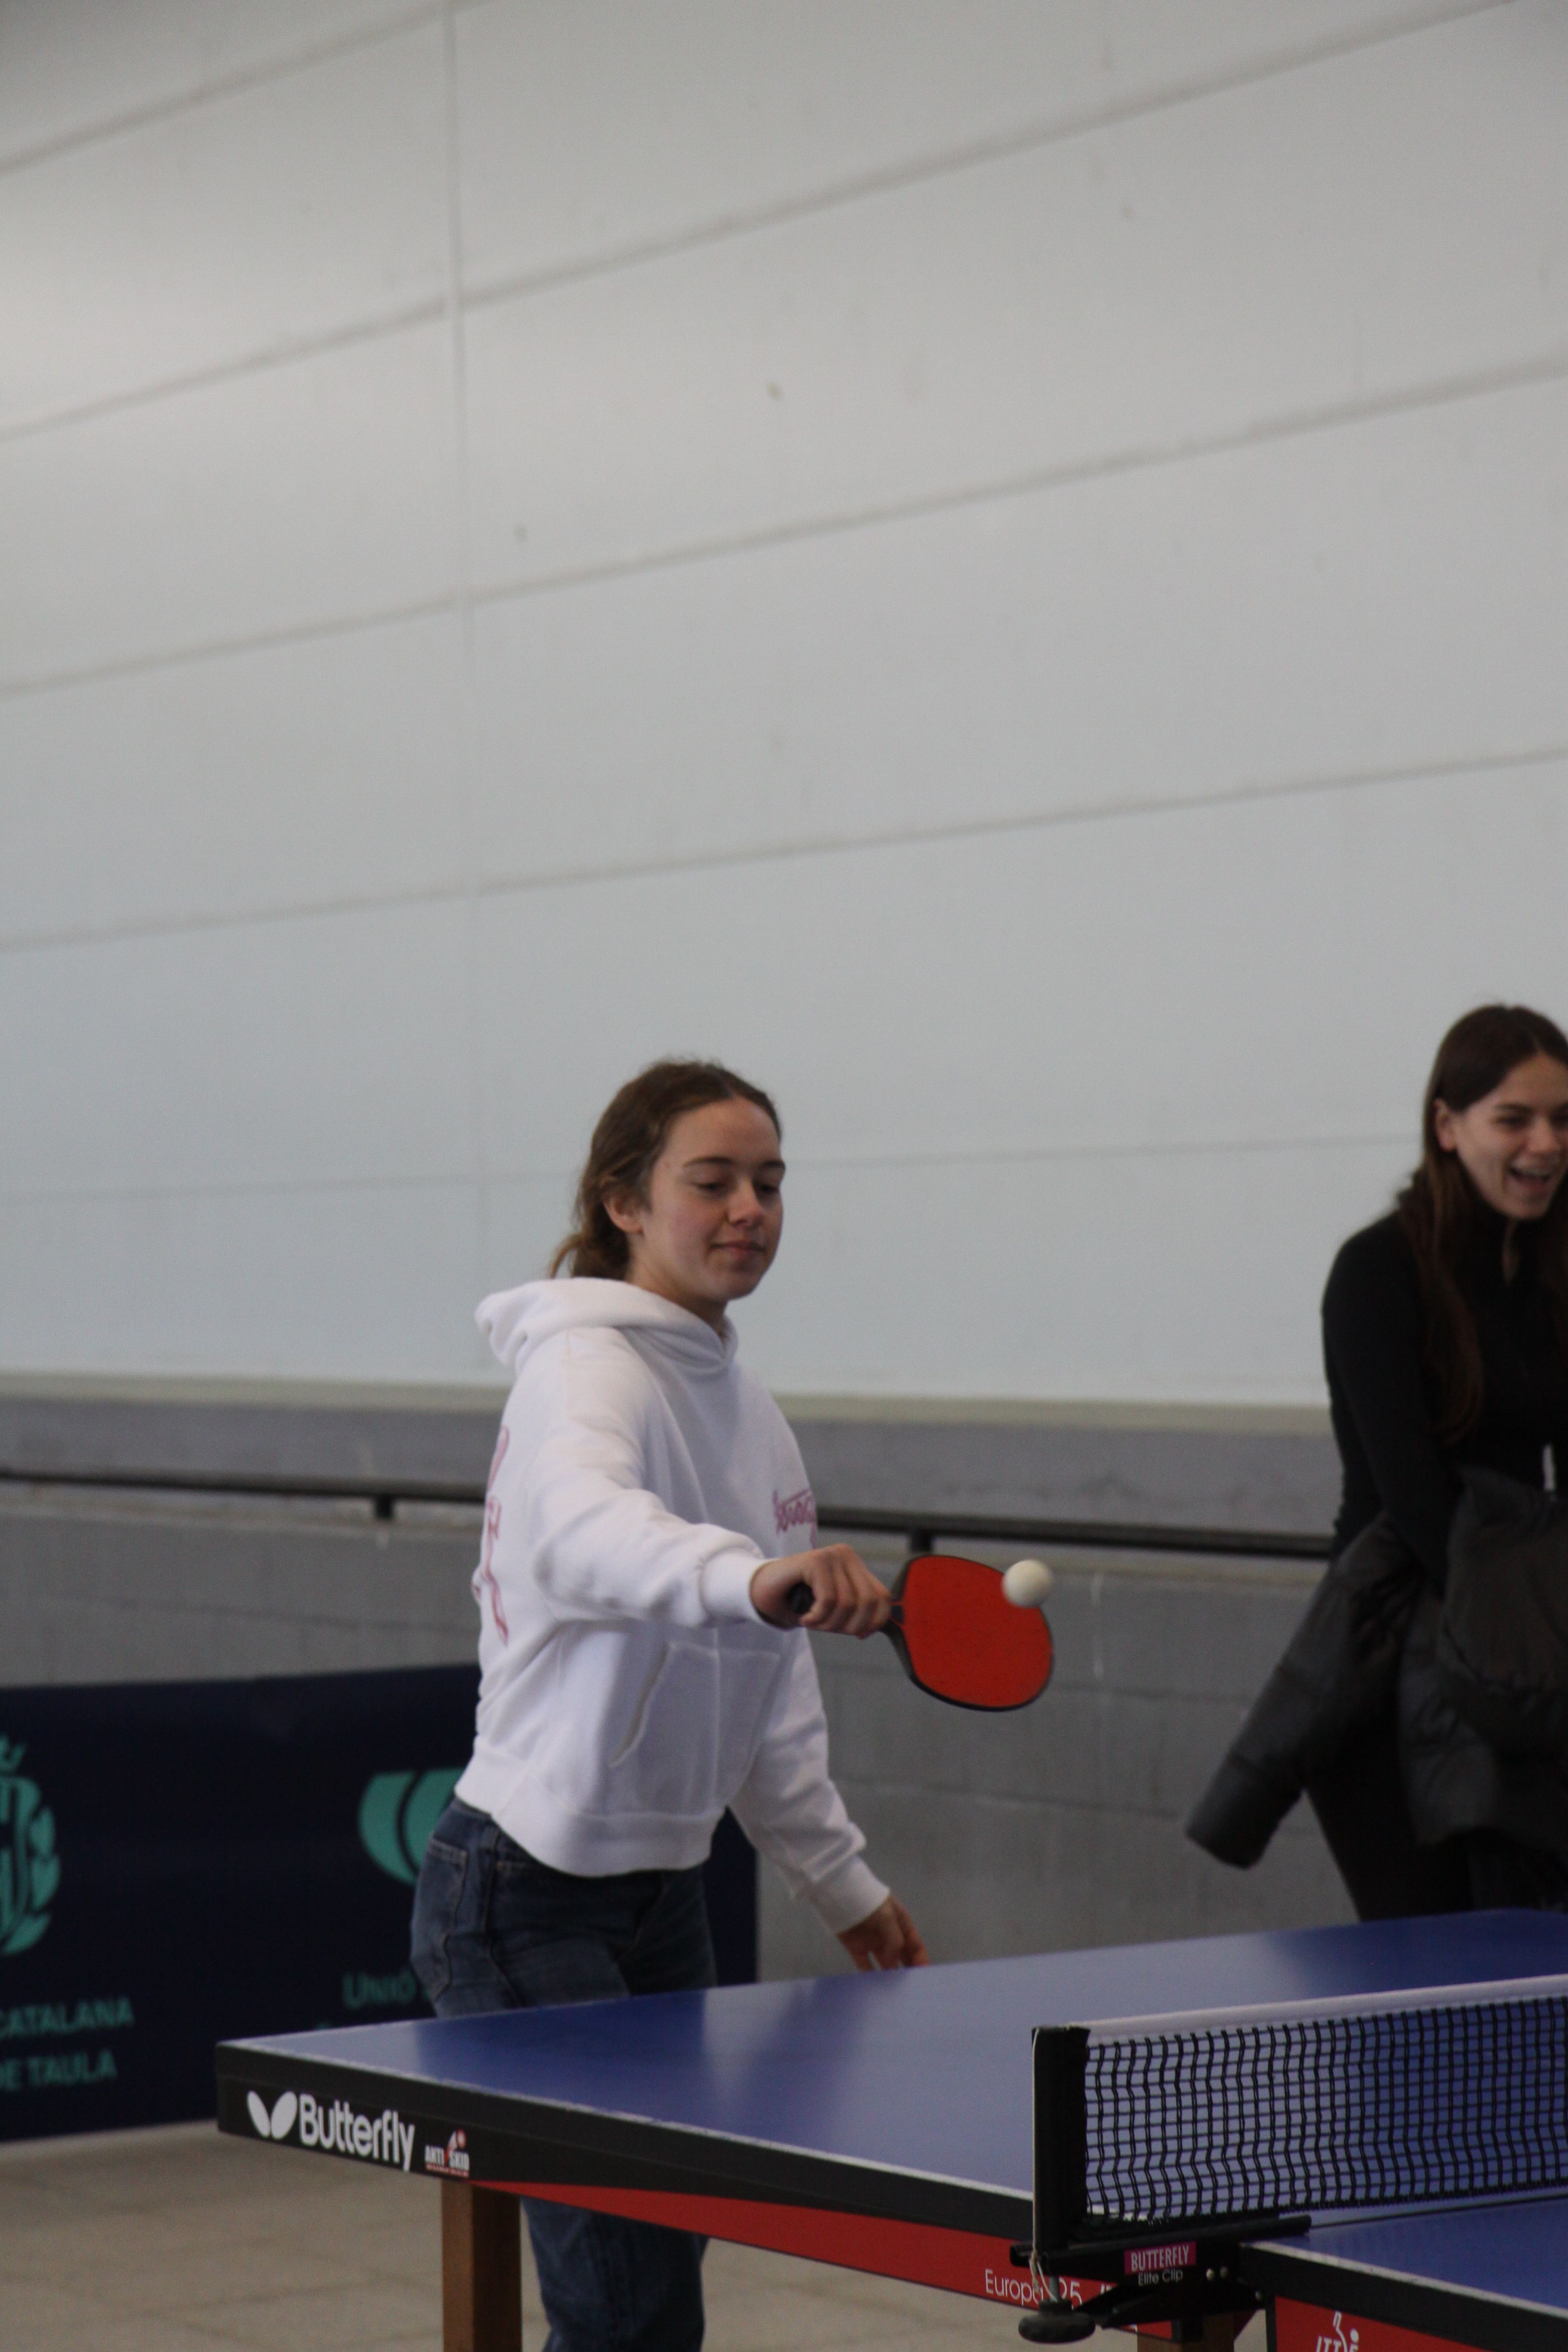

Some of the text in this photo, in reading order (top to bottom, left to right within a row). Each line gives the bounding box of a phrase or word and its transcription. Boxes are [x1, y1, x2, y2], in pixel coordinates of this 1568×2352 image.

[27, 2048, 116, 2084] TAULA
[299, 2094, 415, 2172] Butterfly
[1130, 2244, 1189, 2273] BUTTERFLY
[1138, 2267, 1184, 2287] Elite Clip
